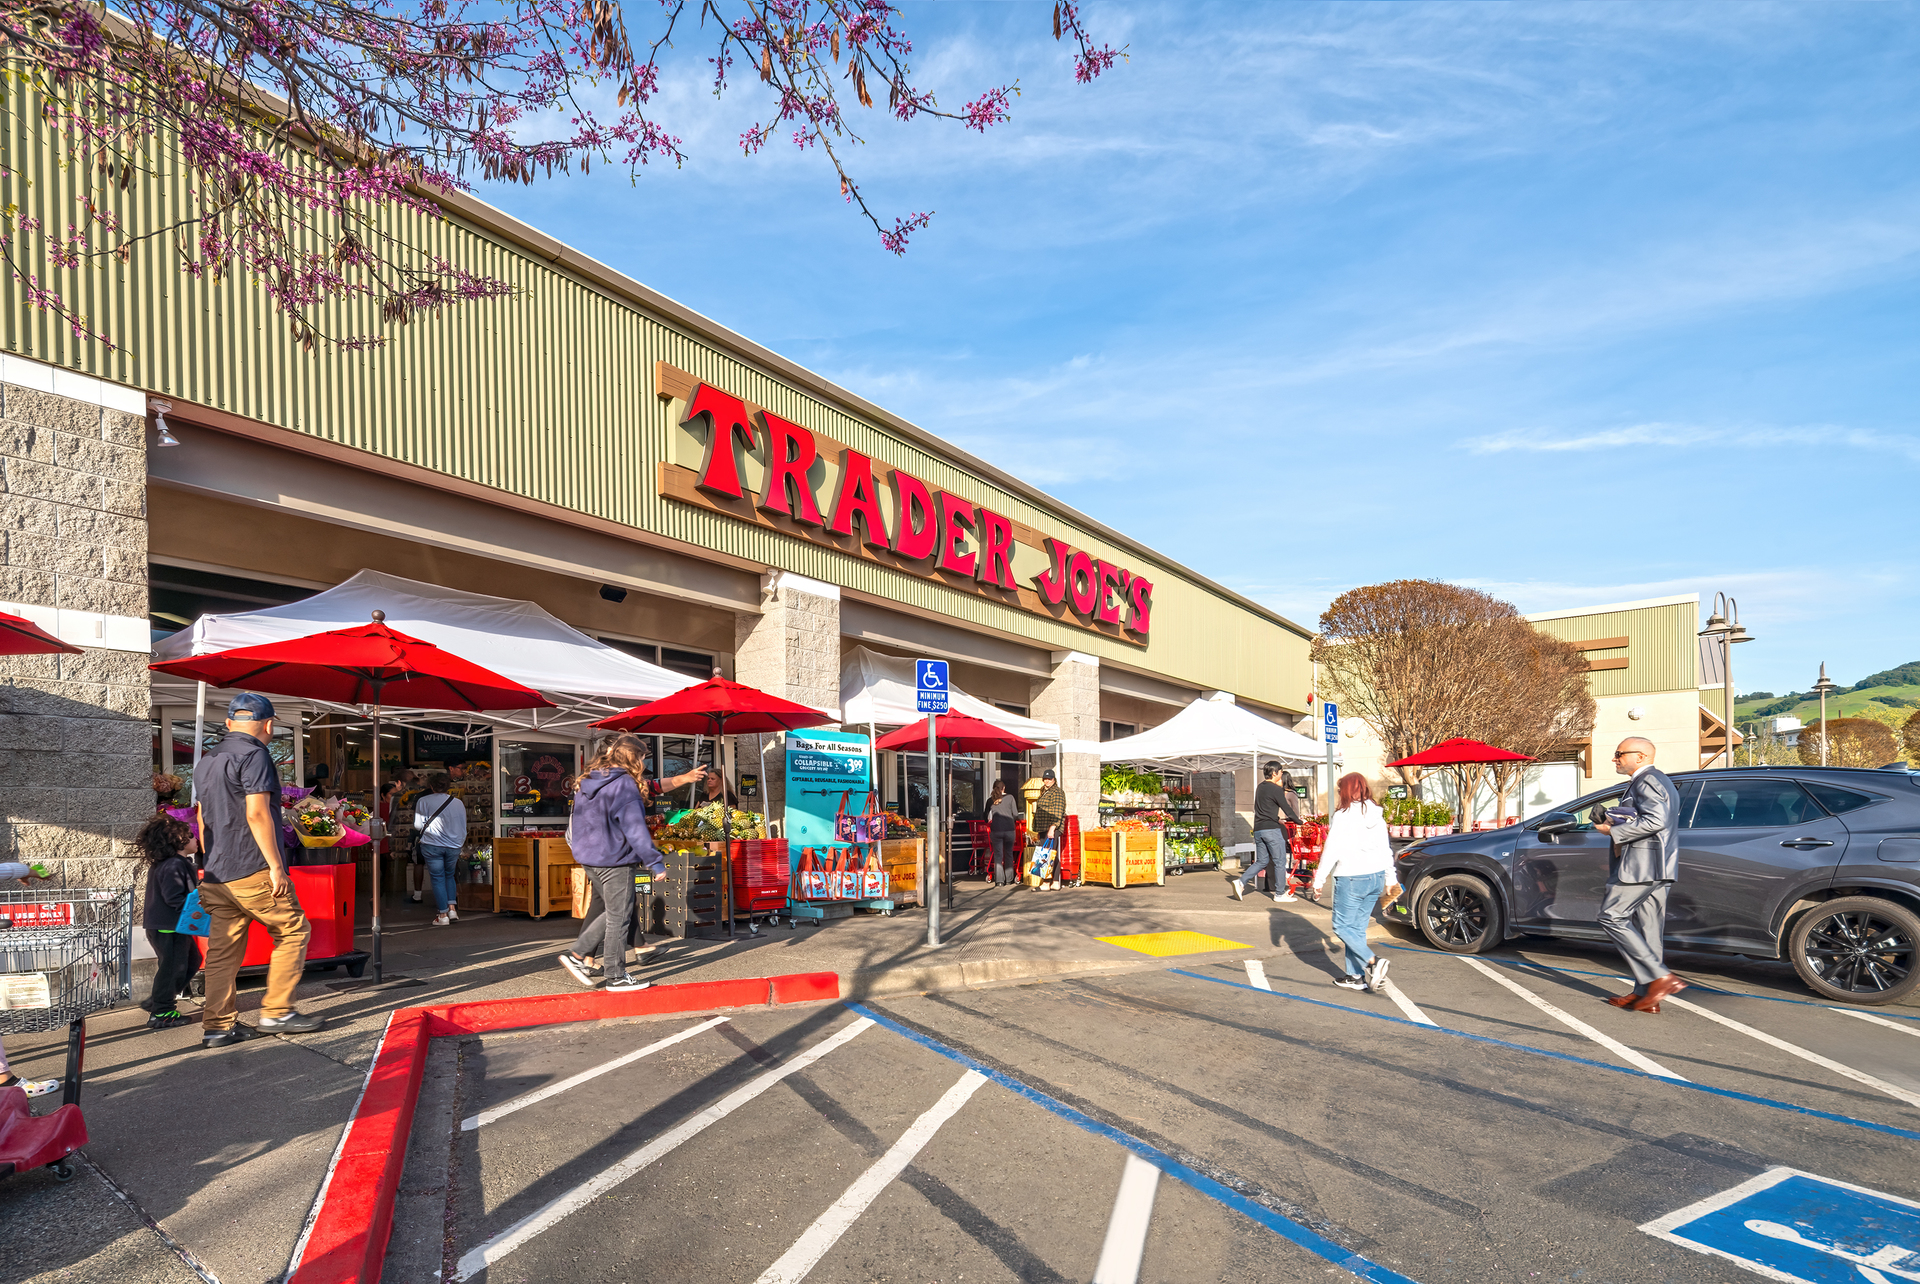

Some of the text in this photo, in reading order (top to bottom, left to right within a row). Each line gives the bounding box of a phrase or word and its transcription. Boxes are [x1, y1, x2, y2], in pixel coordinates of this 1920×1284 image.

[680, 382, 1154, 634] TRADER JOE'S
[920, 692, 946, 700] MINIMUM
[932, 700, 948, 710] $250
[796, 740, 813, 750] Bags
[838, 744, 862, 753] Seasons
[794, 759, 832, 767] COLLAPSIBLE
[514, 776, 531, 794] 8
[902, 872, 916, 880] JOES
